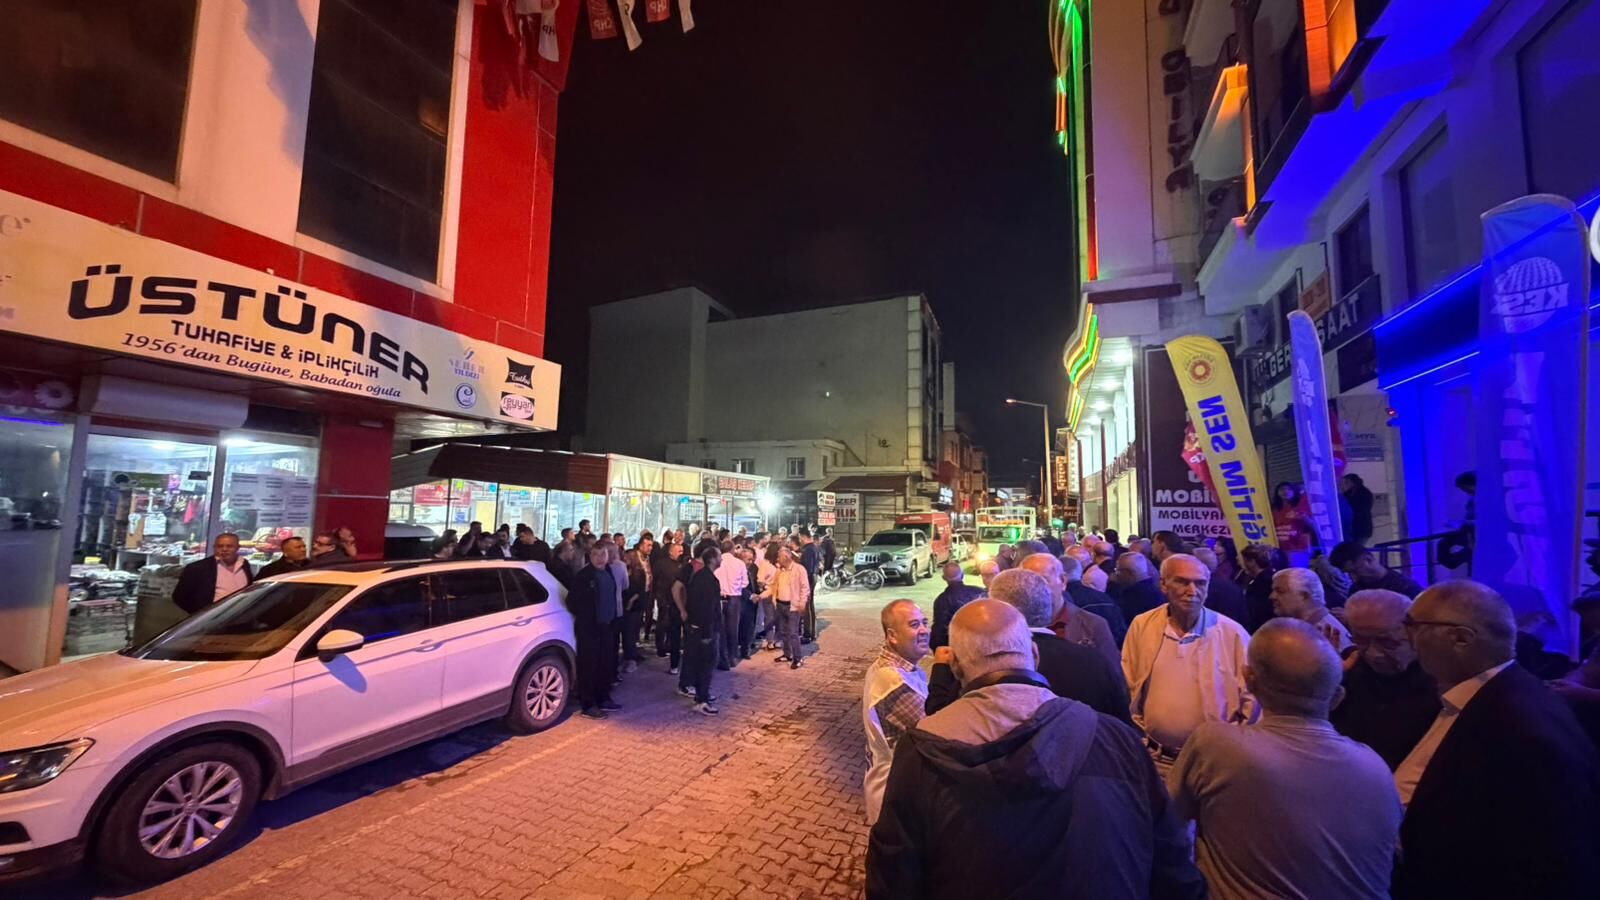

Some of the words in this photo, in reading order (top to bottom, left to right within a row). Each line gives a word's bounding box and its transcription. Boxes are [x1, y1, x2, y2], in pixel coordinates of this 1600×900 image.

[68, 264, 429, 395] ÜSTÜNER
[281, 345, 294, 360] &
[226, 354, 294, 379] Bugüne,
[299, 369, 363, 391] Babadan
